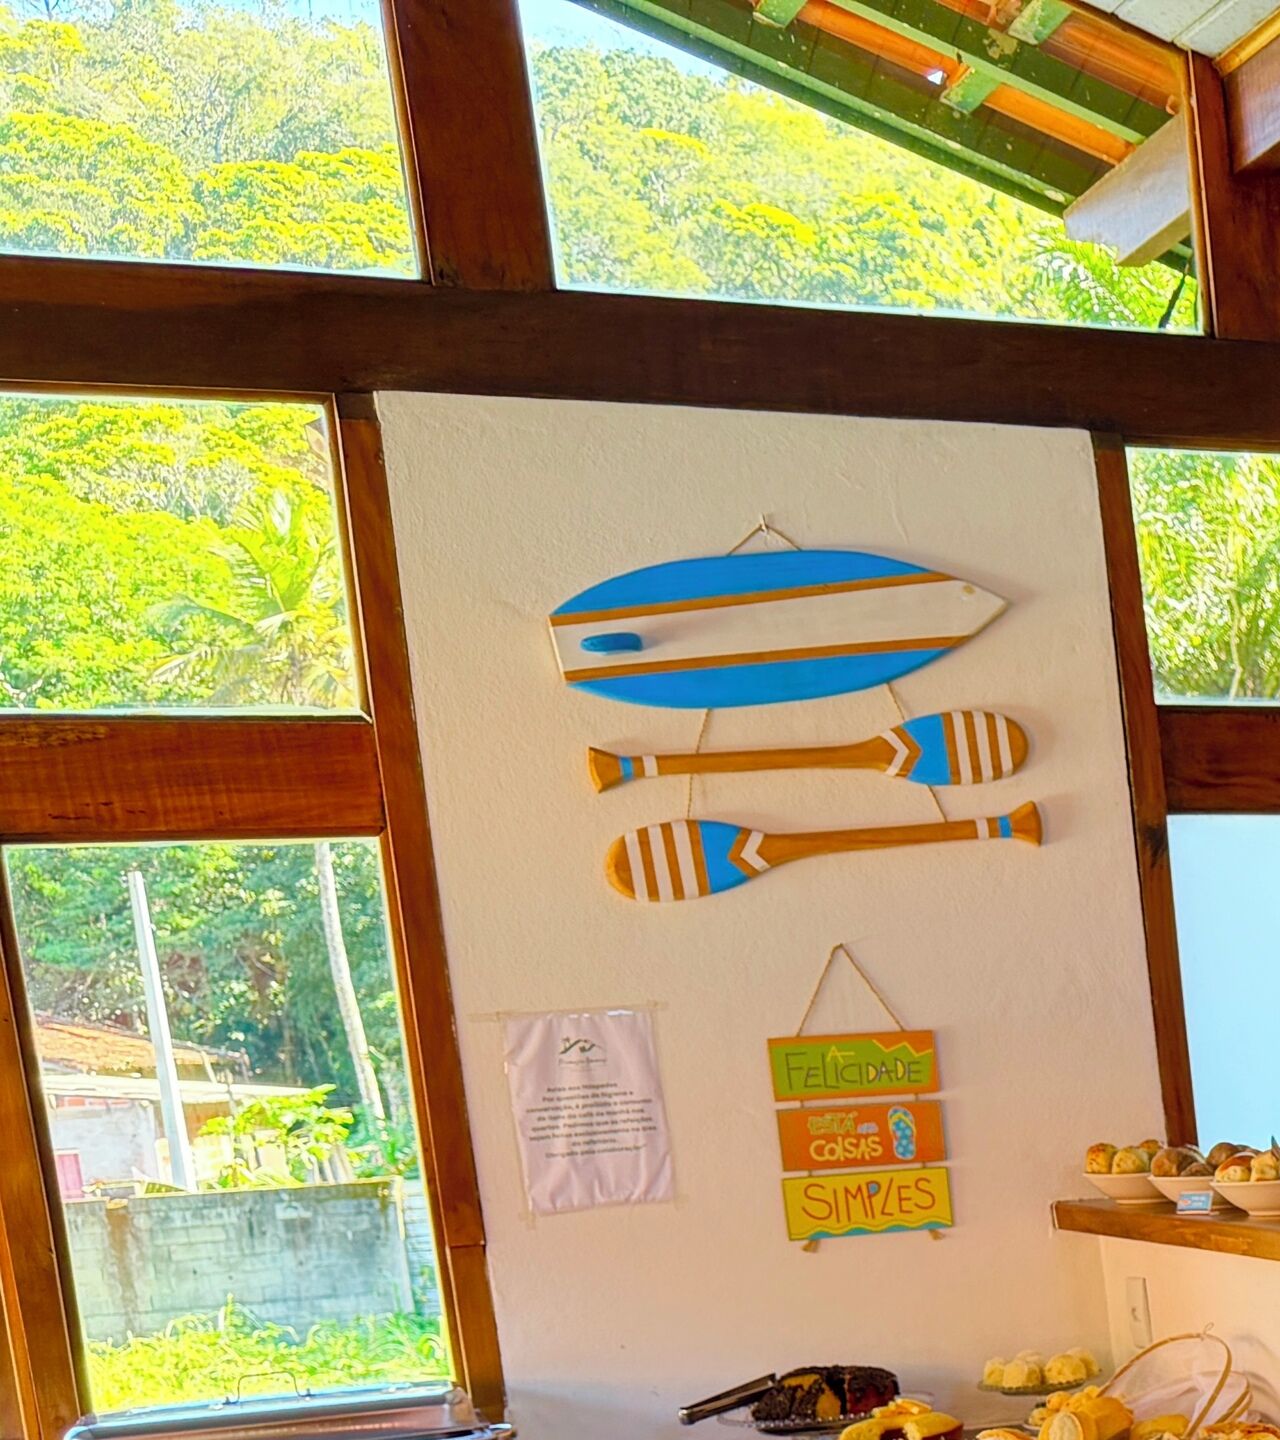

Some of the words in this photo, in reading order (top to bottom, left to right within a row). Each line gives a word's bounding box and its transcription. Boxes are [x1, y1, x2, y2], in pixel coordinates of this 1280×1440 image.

[785, 1052, 922, 1091] FELICIDADE
[808, 1111, 858, 1135] ESTÁ
[809, 1135, 883, 1161] COISAS
[802, 1177, 936, 1223] SIMPLES
